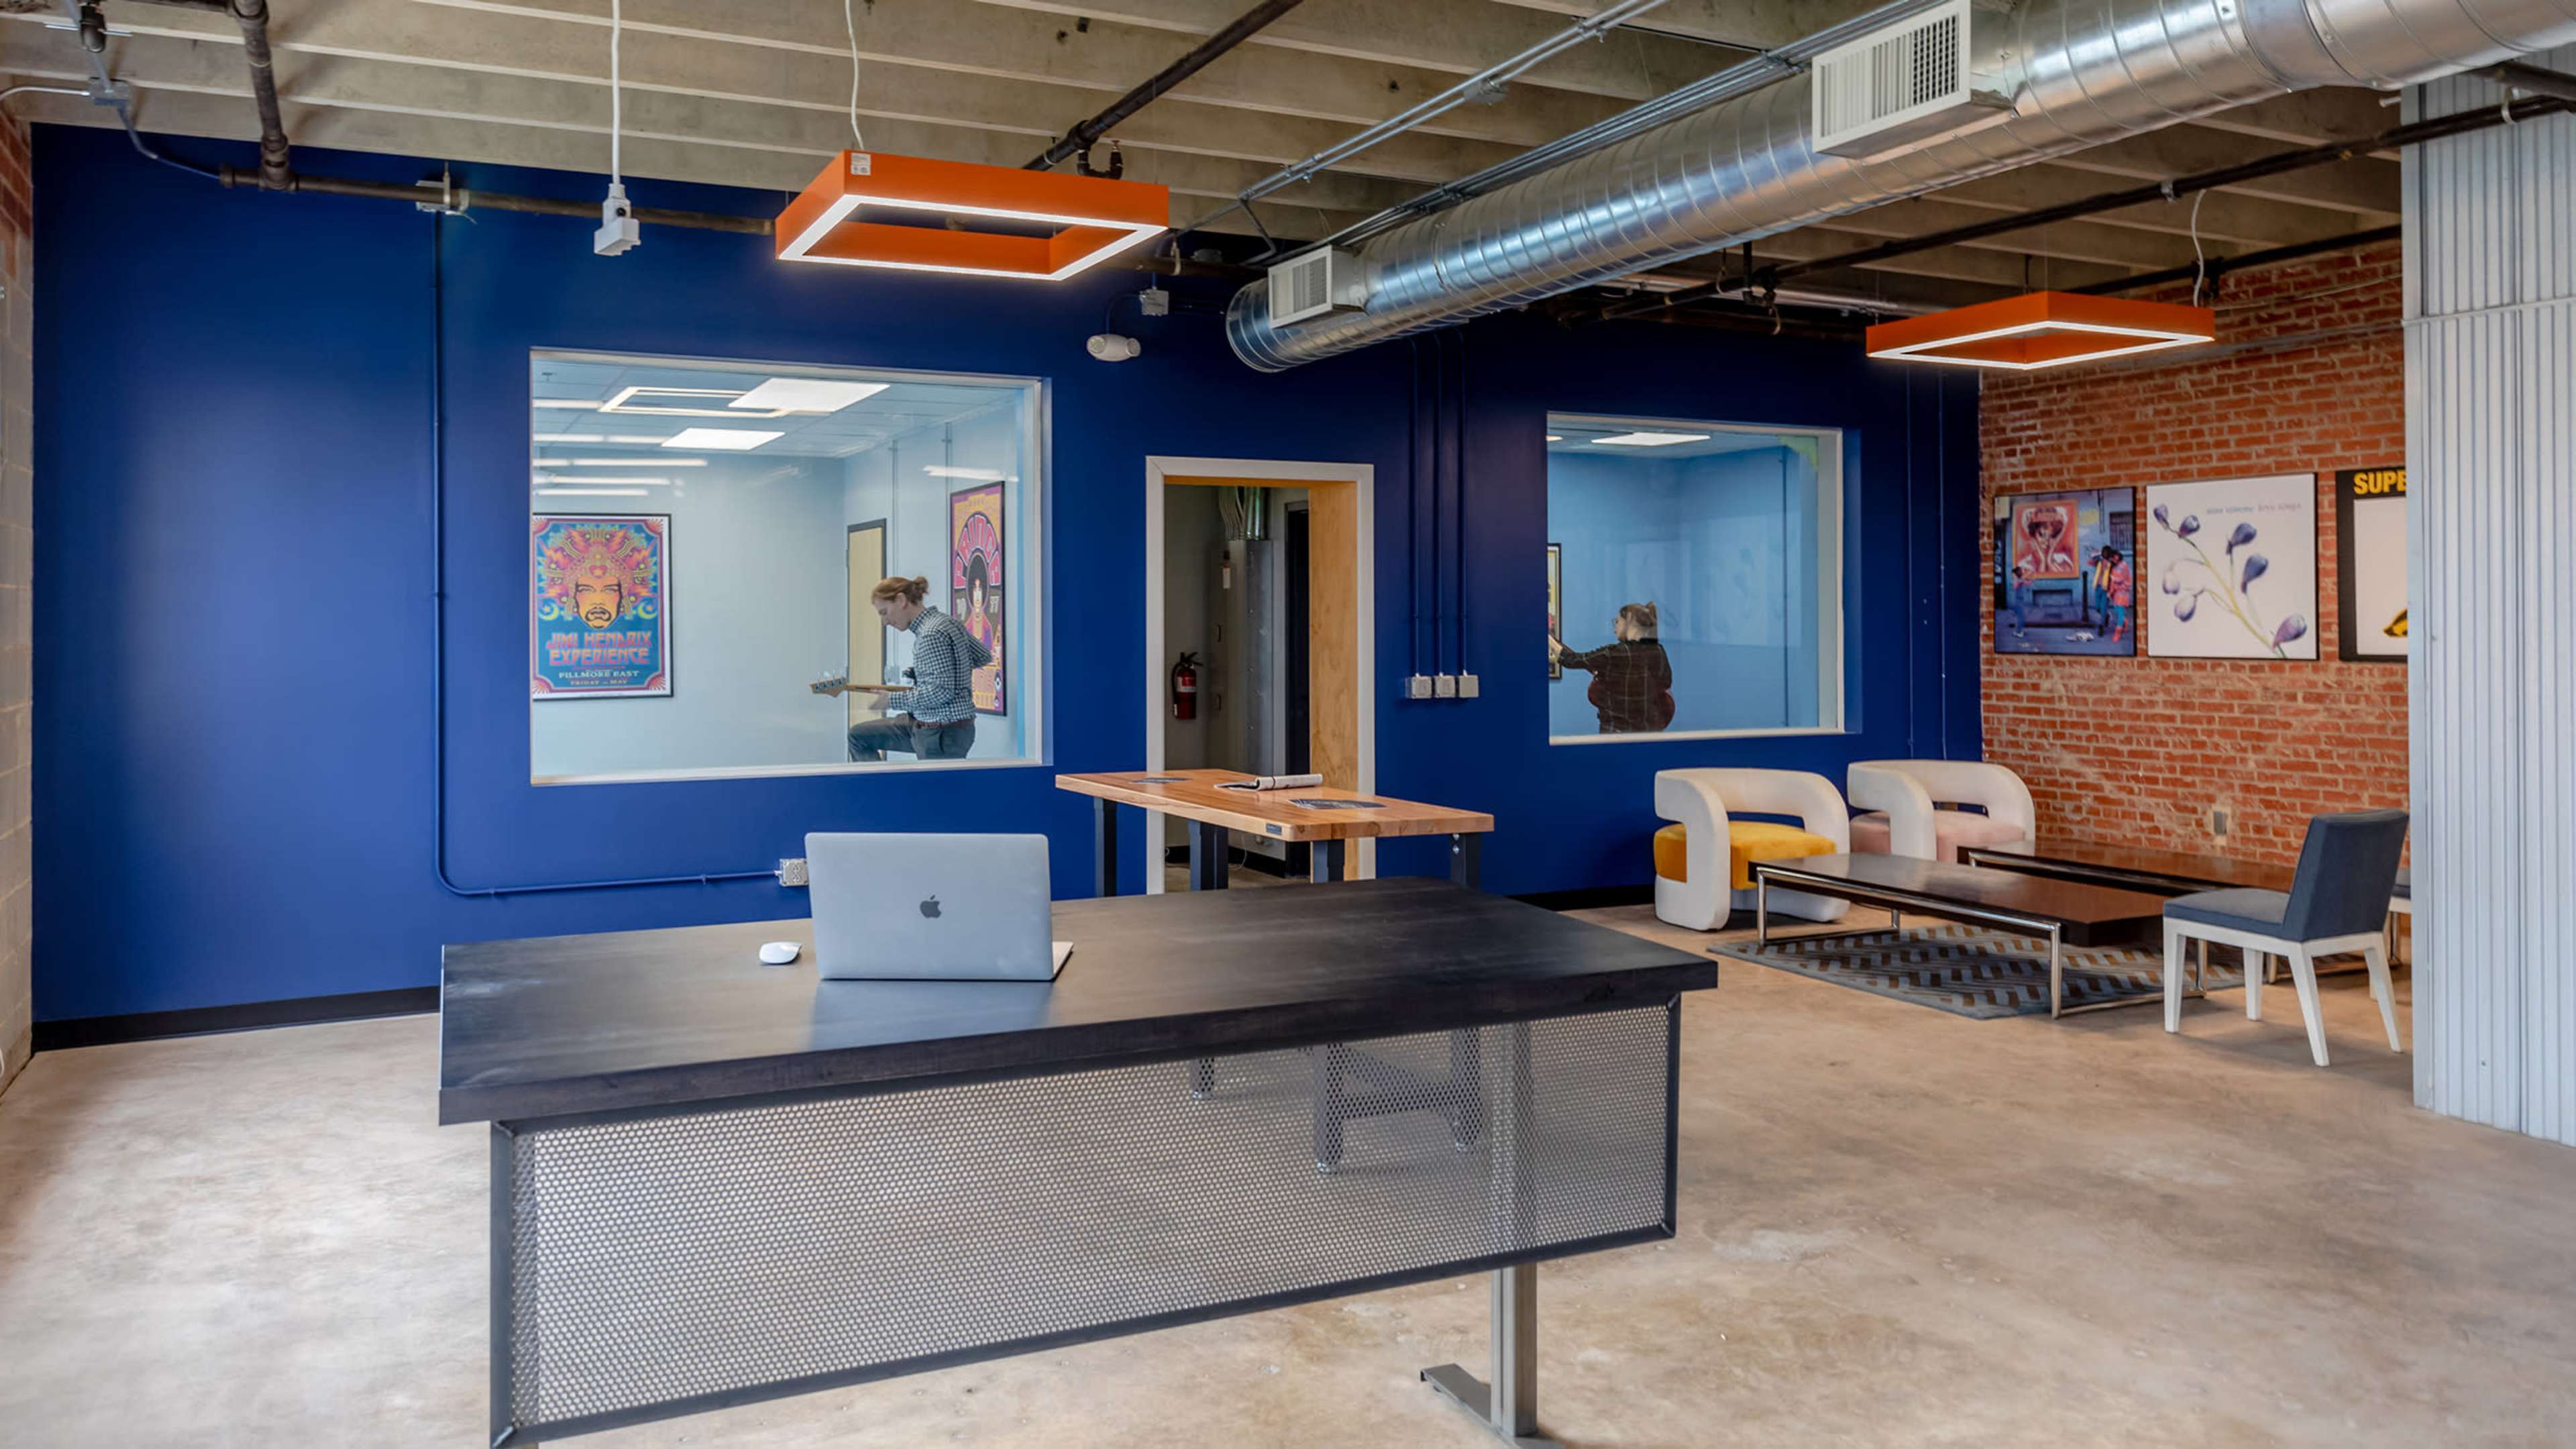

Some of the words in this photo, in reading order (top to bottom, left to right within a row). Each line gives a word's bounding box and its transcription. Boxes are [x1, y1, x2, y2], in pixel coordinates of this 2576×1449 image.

[547, 633, 578, 649] JIMI
[584, 631, 651, 648] HENDRIX
[549, 648, 650, 665] EXPERIENCE
[558, 670, 610, 678] FILLMORE
